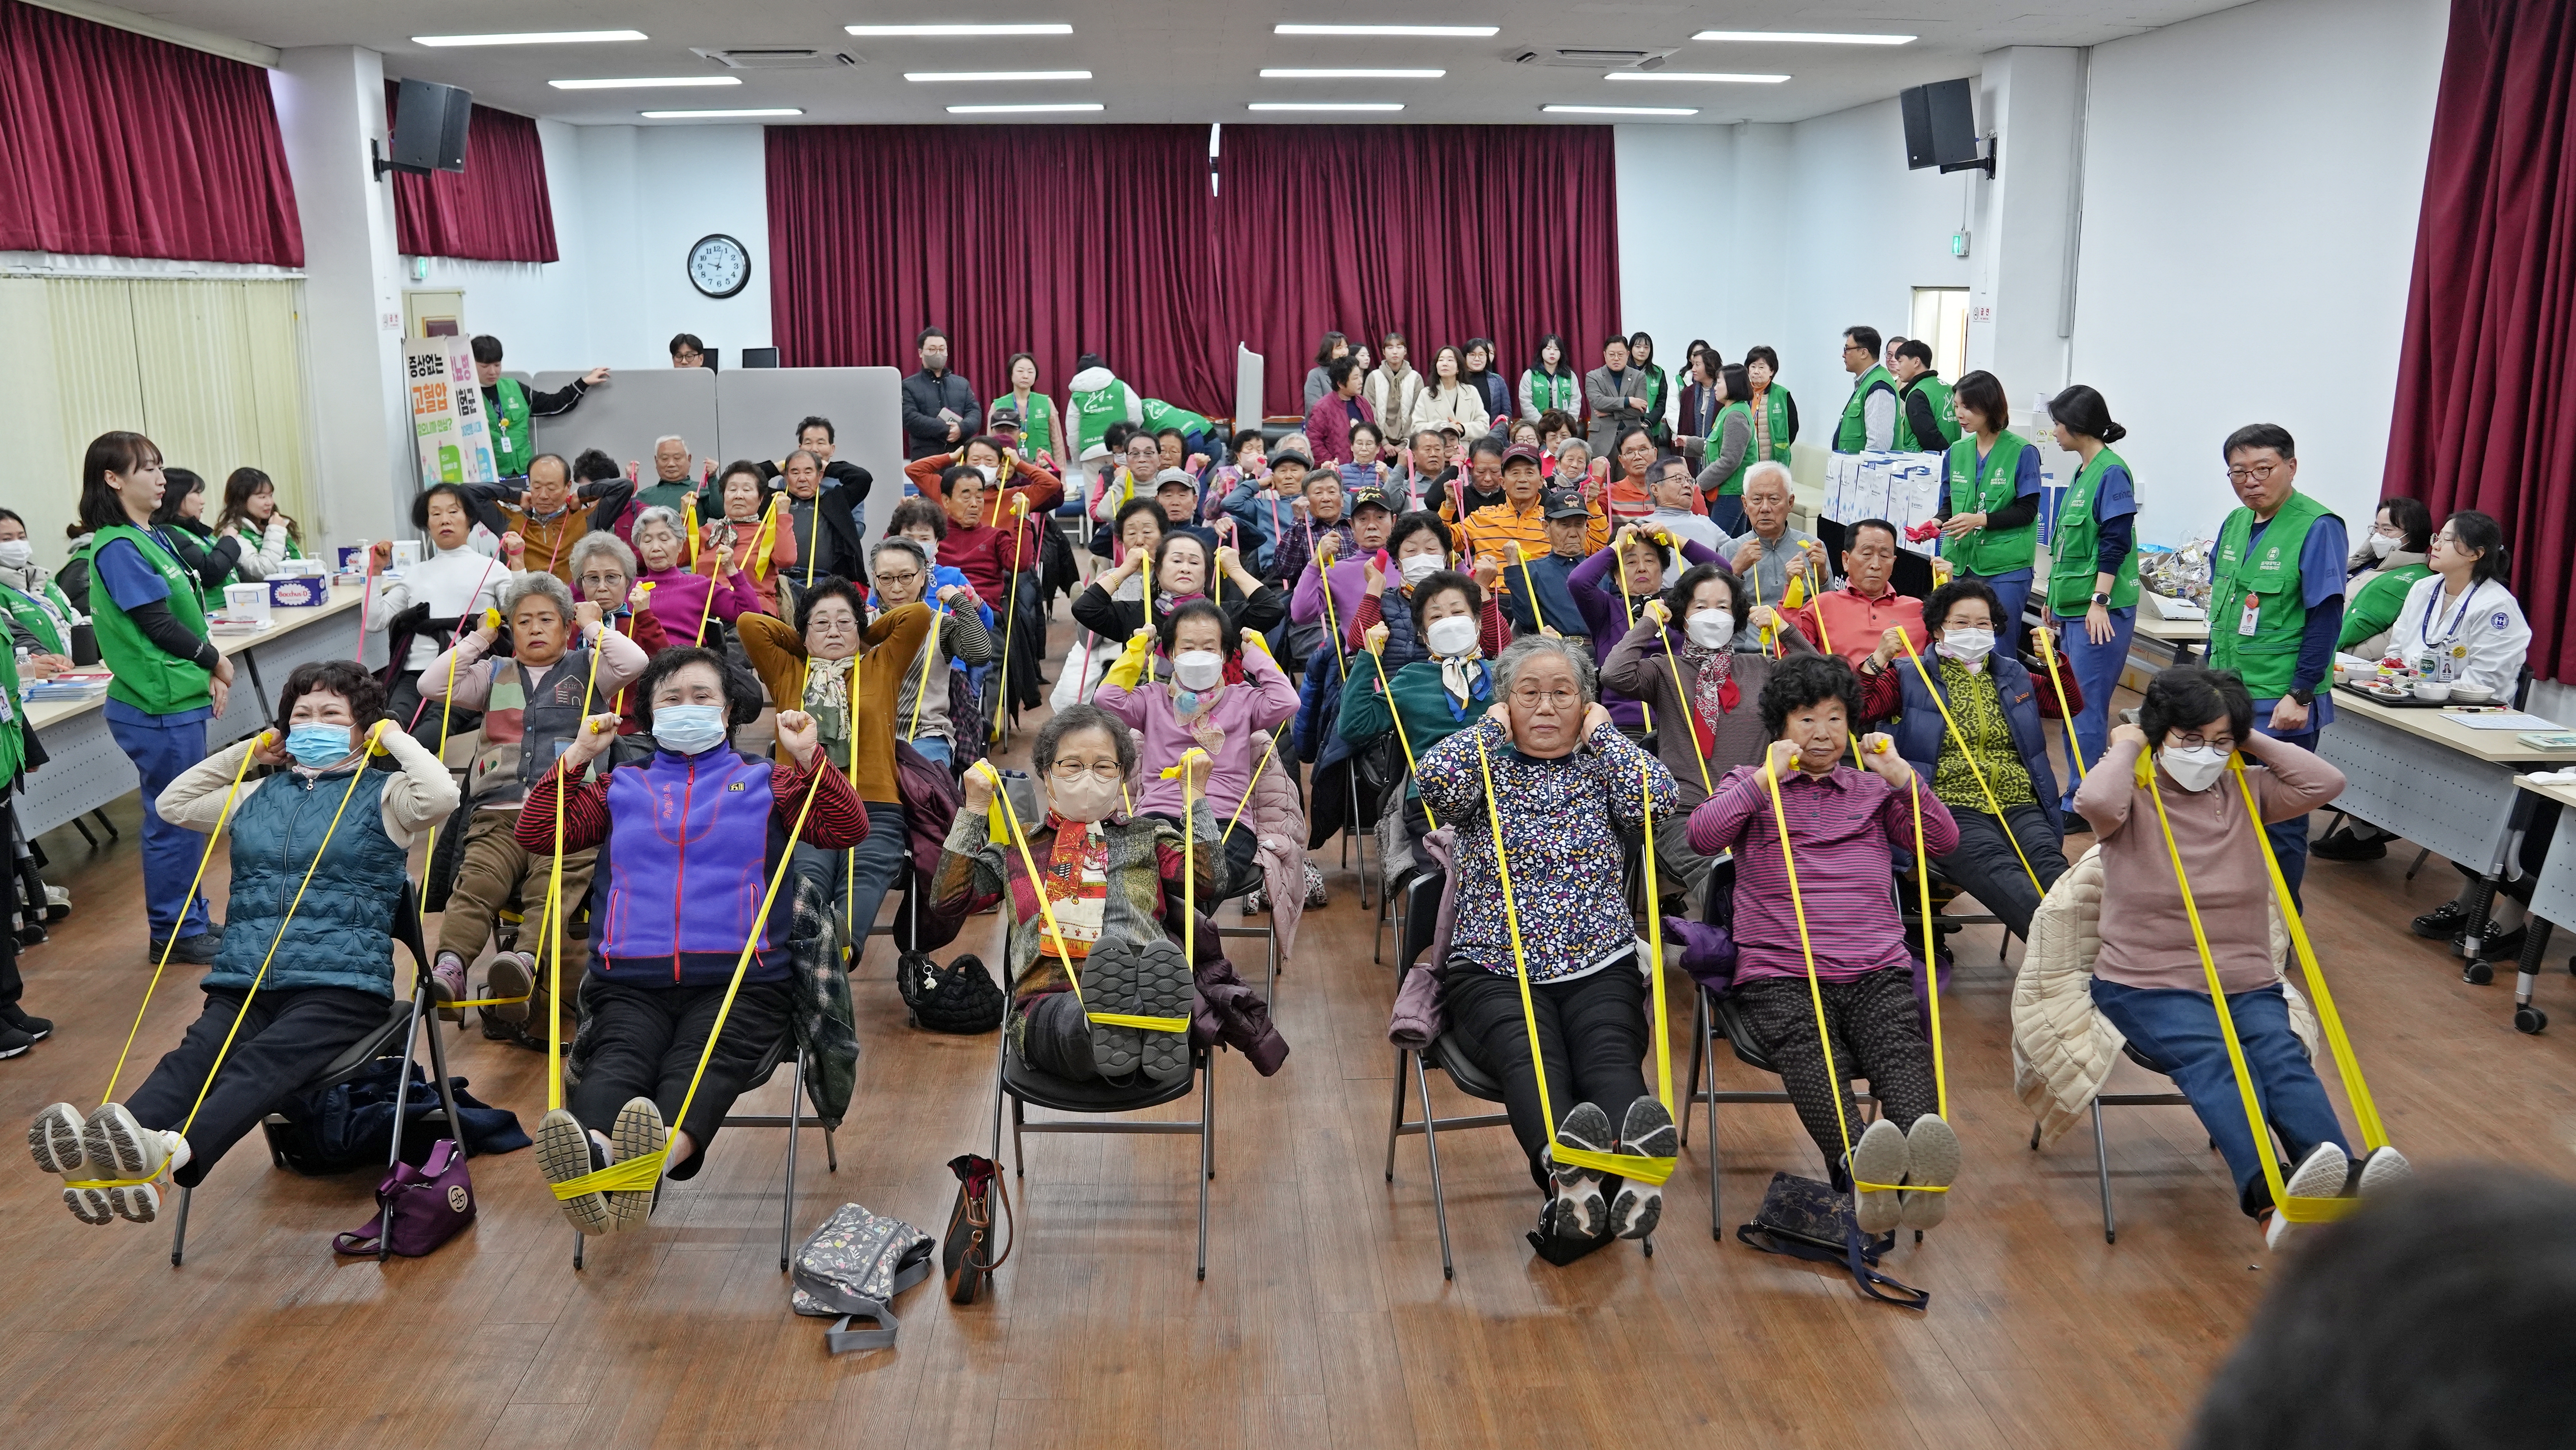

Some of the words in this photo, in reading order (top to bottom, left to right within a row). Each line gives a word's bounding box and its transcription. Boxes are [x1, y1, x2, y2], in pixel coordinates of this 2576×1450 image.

[409, 354, 443, 378] 증상없는
[450, 354, 471, 382] 뇨병
[412, 382, 448, 415] 고혈압
[456, 388, 476, 417] 험군
